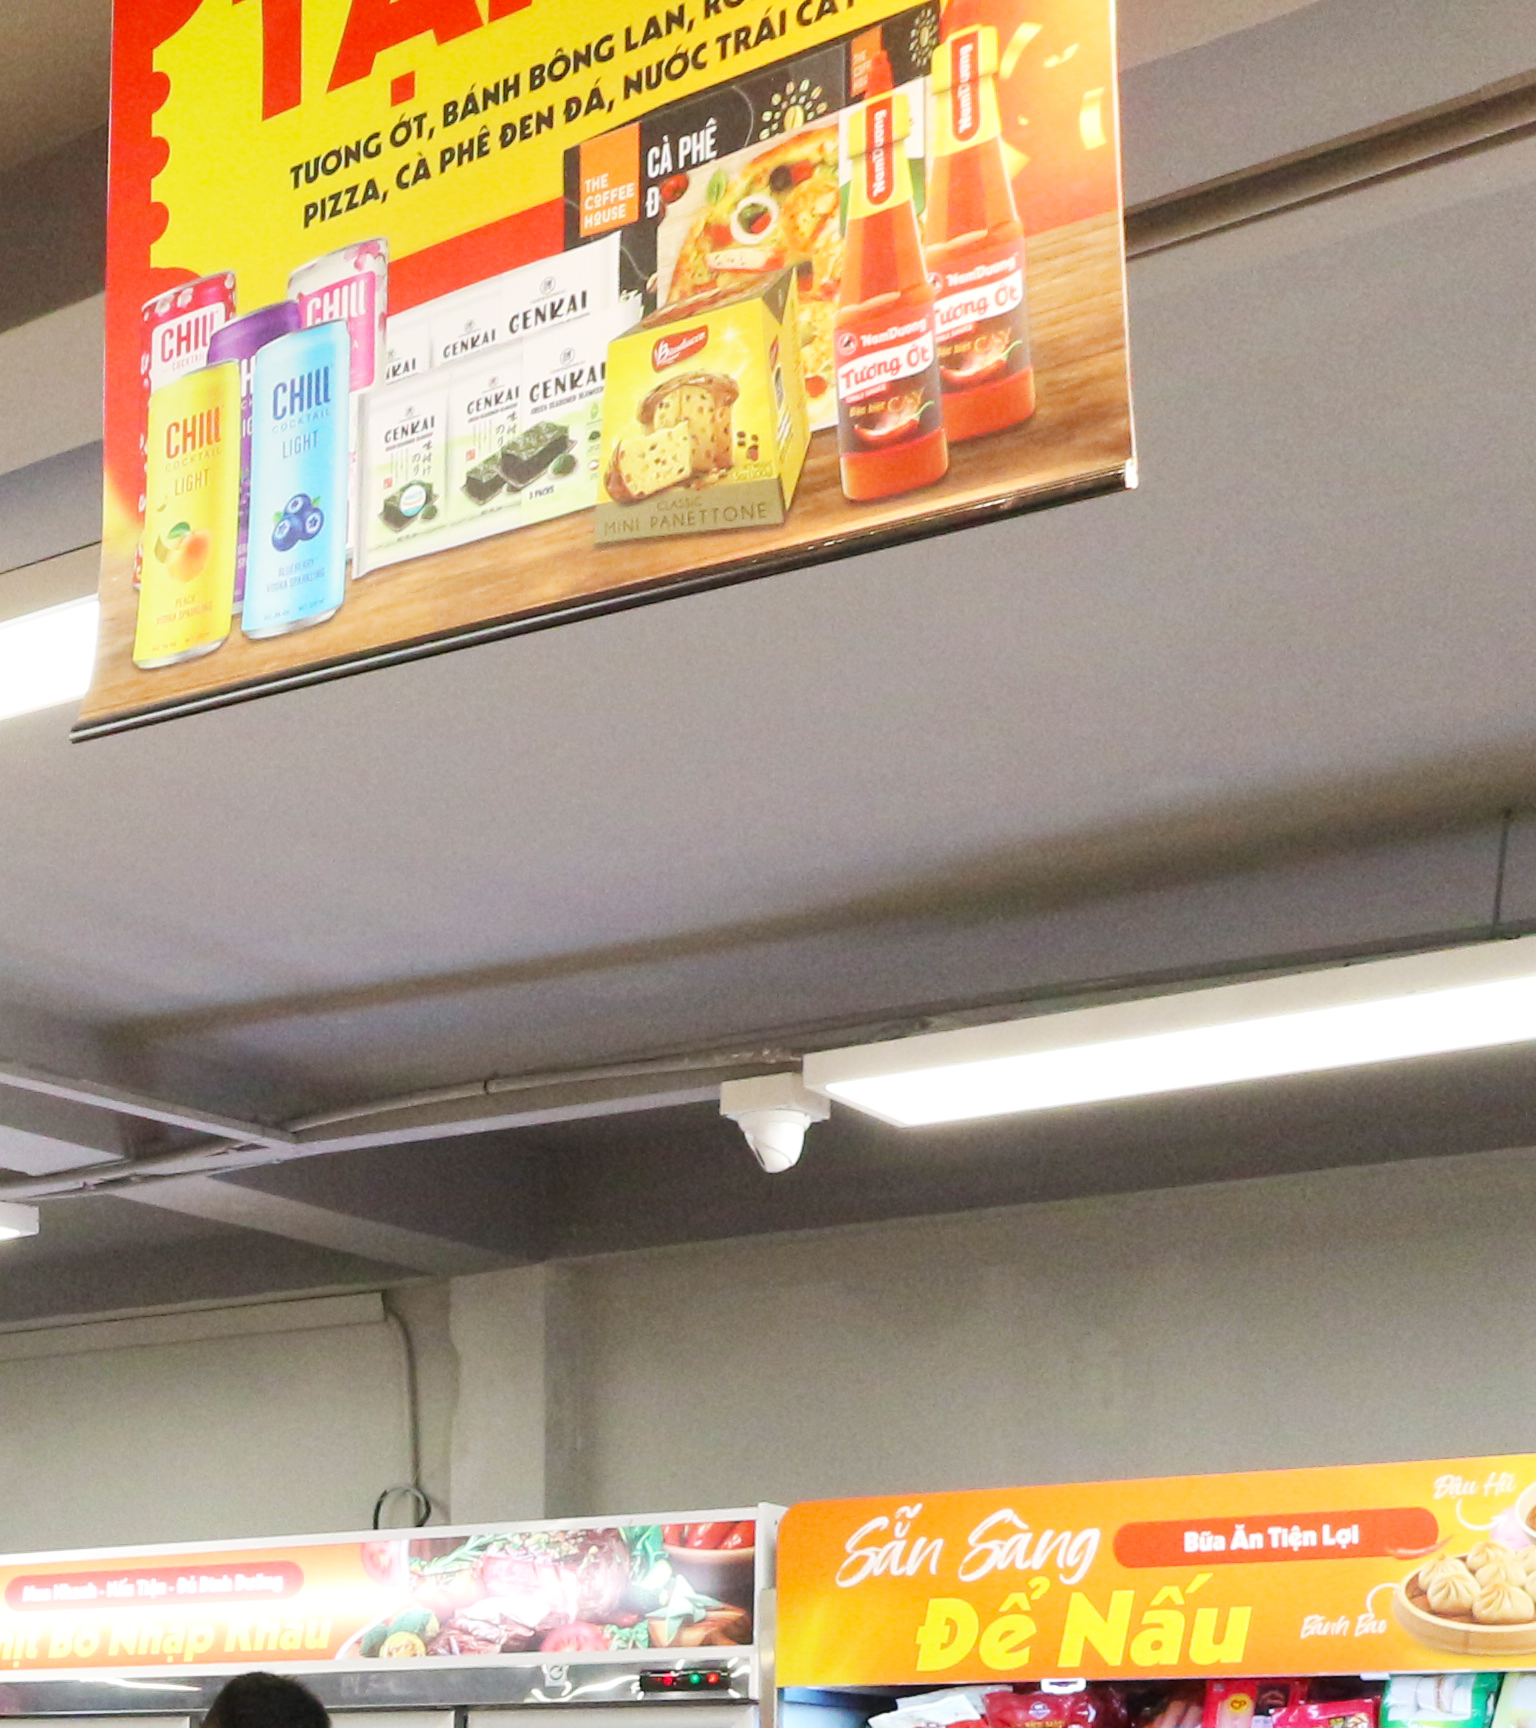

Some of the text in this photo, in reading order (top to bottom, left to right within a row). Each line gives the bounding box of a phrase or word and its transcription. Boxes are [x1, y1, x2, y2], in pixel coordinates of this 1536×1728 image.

[290, 3, 694, 189] TƯƠNG ỚT, BÁNH BÔNG LAN,
[303, 178, 390, 229] PIZZA,
[395, 152, 431, 191] CÀ
[439, 125, 492, 175] PHÊ
[500, 108, 555, 150] ĐEN
[563, 78, 616, 122] ĐÁ,
[623, 41, 708, 100] NƯỚC
[716, 6, 788, 61] TRÁI
[646, 116, 718, 180] CÀ PHÊ
[584, 173, 609, 192] THE
[584, 182, 636, 211] COFFEE
[584, 203, 627, 230] HOUSE
[509, 290, 588, 335] GENKAI
[442, 328, 497, 360] GENKAI
[272, 365, 332, 422] CHILL
[529, 361, 607, 404] GENKAI
[466, 385, 520, 416] GENKAI
[166, 406, 222, 460] CHILL
[282, 430, 319, 460] LIGHT
[384, 415, 435, 445] GENKAI
[174, 468, 211, 496] LIGHT
[605, 502, 768, 536] MINI PANETTONE
[958, 1508, 1101, 1587] Sàng
[1184, 1525, 1226, 1554] Bữa
[1229, 1524, 1263, 1552] Ăn
[1267, 1525, 1316, 1554] Tiện
[916, 1572, 1252, 1673] Để Nấu
